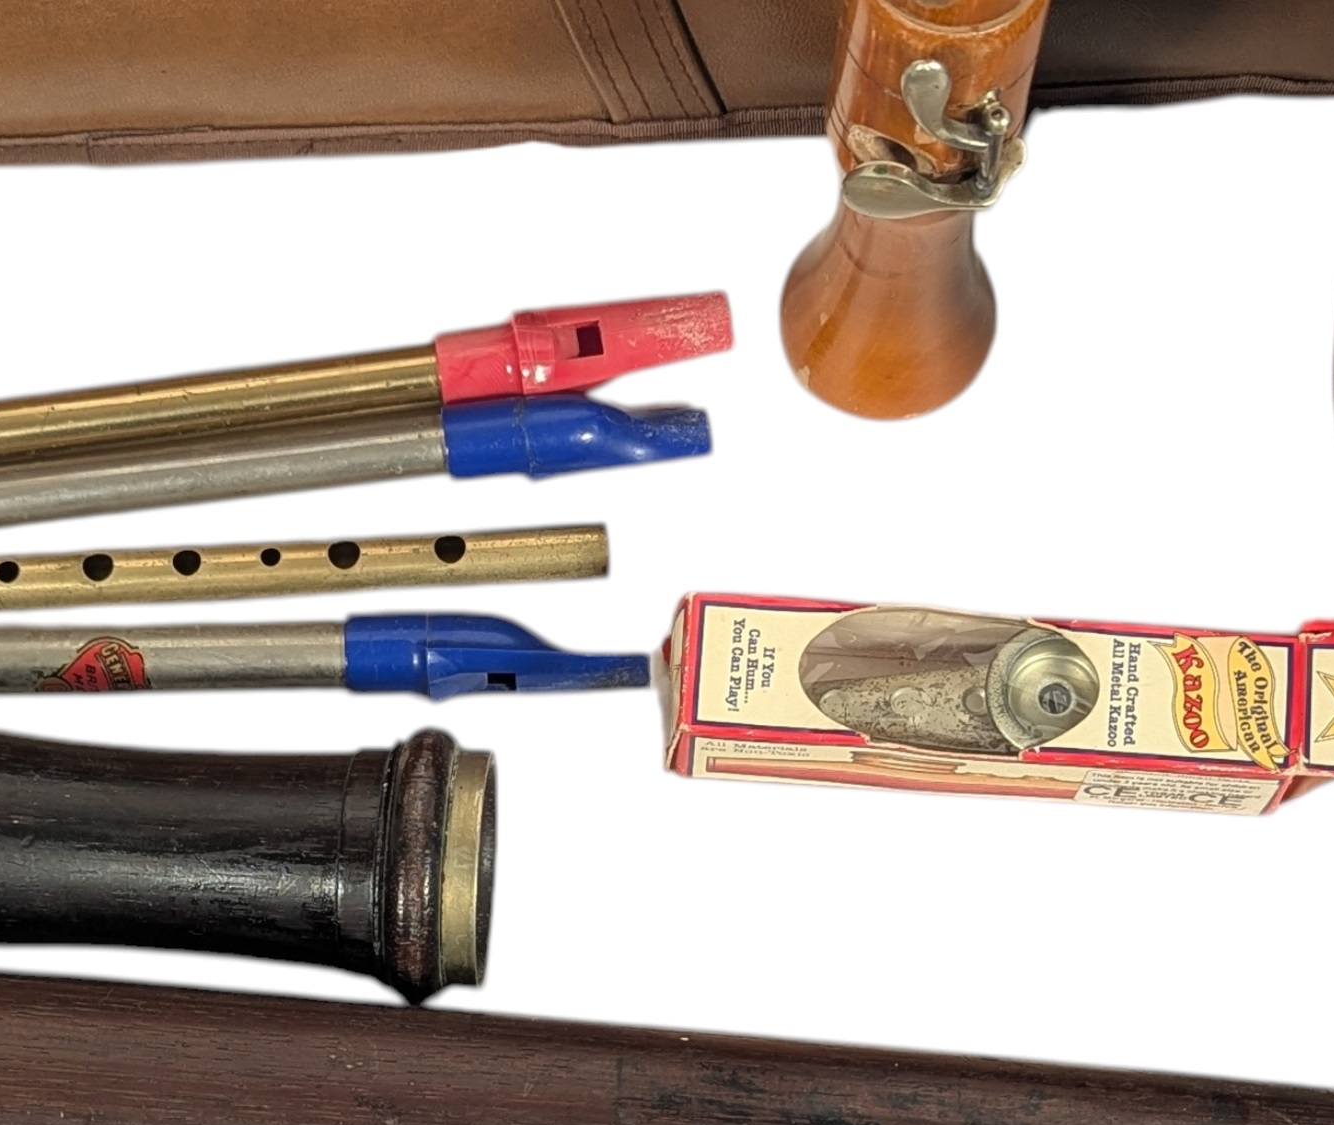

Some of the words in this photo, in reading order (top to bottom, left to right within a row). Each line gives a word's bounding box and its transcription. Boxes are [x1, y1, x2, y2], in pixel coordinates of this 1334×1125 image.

[733, 618, 746, 644] You
[748, 629, 760, 655] Can
[1112, 638, 1123, 659] All
[731, 647, 744, 672] Can
[764, 647, 775, 660] If
[1128, 643, 1141, 683] Hand
[725, 676, 742, 712] Play!
[744, 658, 758, 704] Hum...
[761, 662, 774, 688] You
[1110, 660, 1124, 702] Metal
[1123, 685, 1139, 746] Crafted
[1172, 644, 1210, 749] Kazoo
[1233, 670, 1261, 754] American
[1238, 641, 1262, 672] The
[1250, 676, 1279, 752] Original
[1107, 704, 1122, 747] Kazoo
